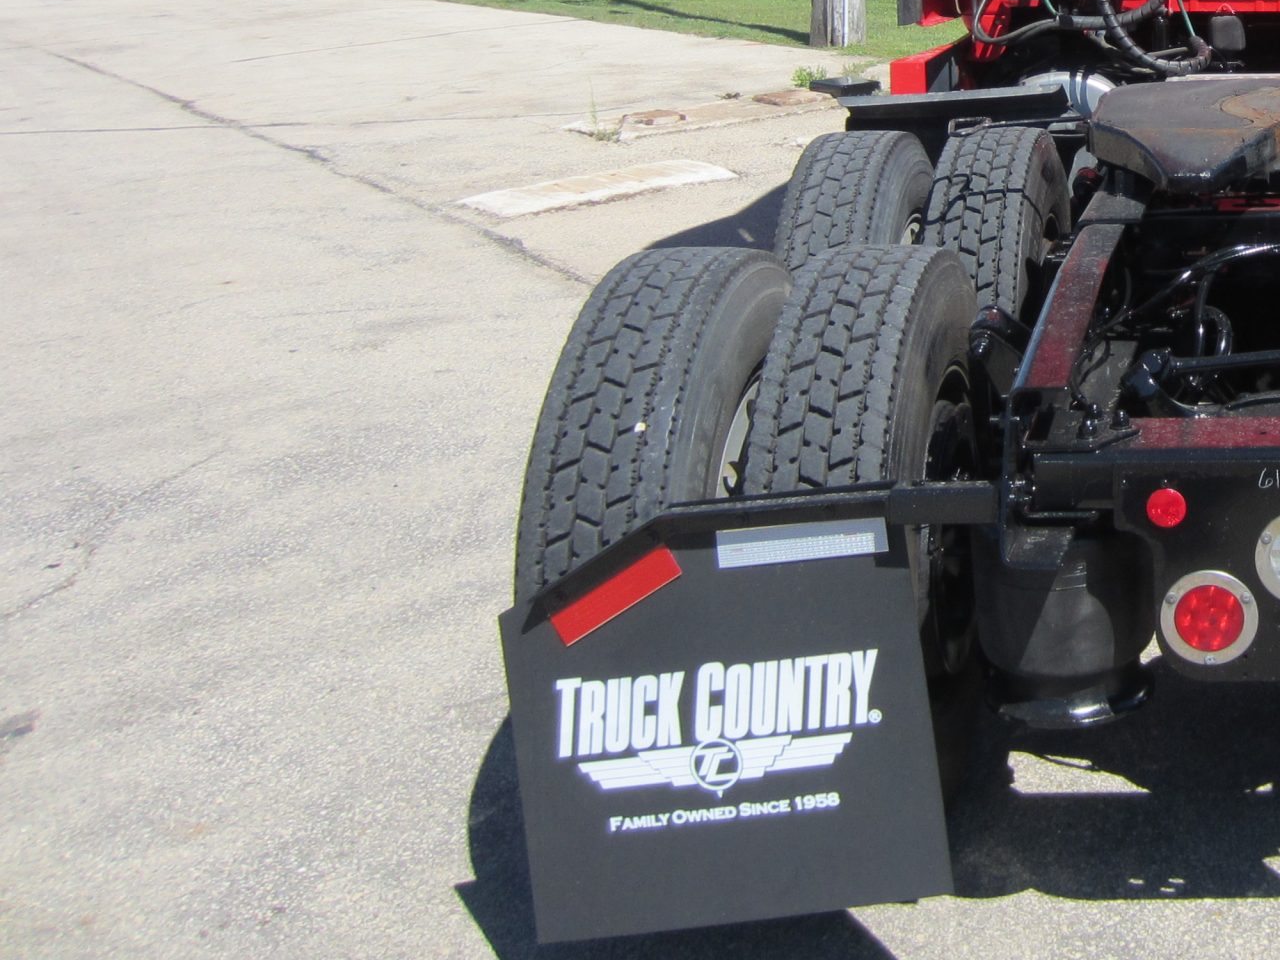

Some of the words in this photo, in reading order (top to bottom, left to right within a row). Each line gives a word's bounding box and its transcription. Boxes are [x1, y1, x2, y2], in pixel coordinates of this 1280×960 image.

[556, 670, 686, 758] TRUCK
[609, 813, 671, 831] FAMILY
[672, 806, 737, 824] OWNED
[739, 799, 791, 817] SINCE
[794, 792, 841, 811] 1958
